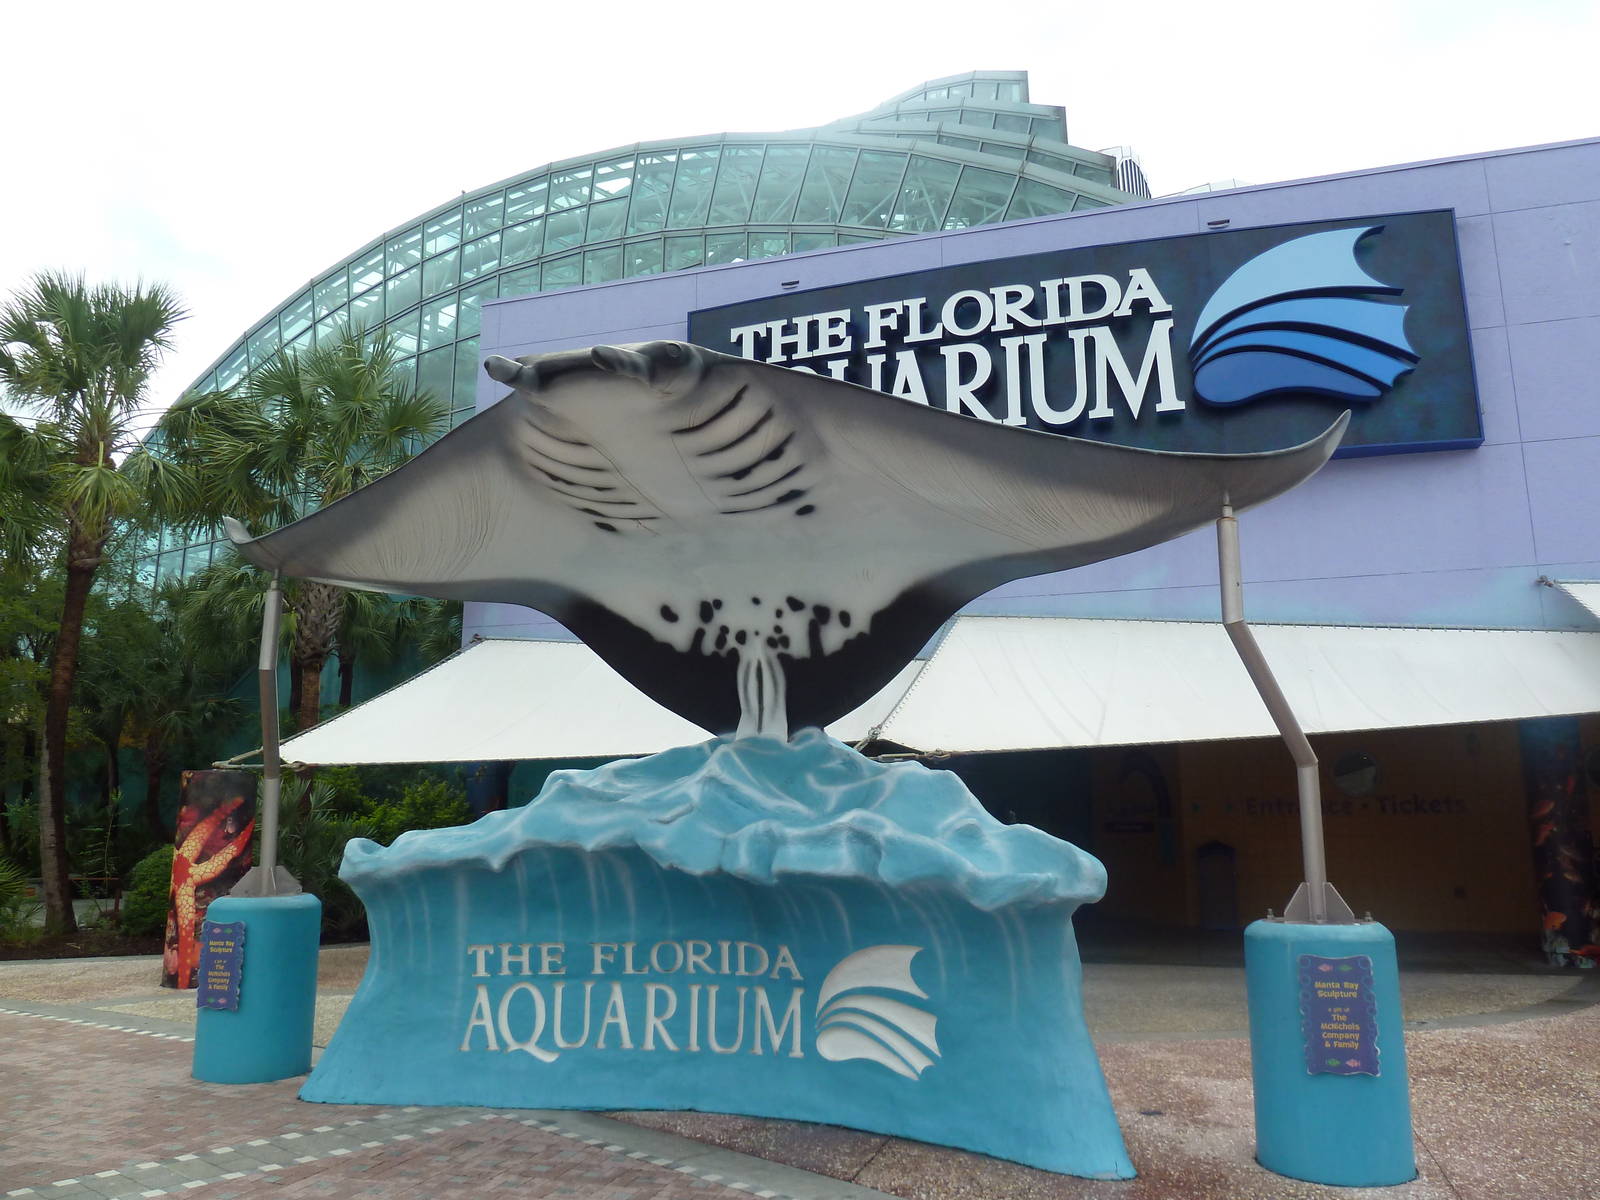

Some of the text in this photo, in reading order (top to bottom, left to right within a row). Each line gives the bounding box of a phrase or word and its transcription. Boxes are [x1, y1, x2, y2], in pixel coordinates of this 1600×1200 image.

[730, 267, 1173, 364] THE FLORIDA
[789, 318, 1187, 426] ARIUM
[1246, 793, 1468, 815] Entrce Tickets
[467, 940, 804, 980] THE FLORIDA
[1314, 981, 1359, 990] Manta Ray
[1316, 990, 1358, 999] Sculpture
[459, 980, 805, 1064] AQUARIUM
[1332, 1014, 1348, 1022] The
[1322, 1031, 1360, 1040] Company
[1333, 1040, 1359, 1049] Family
